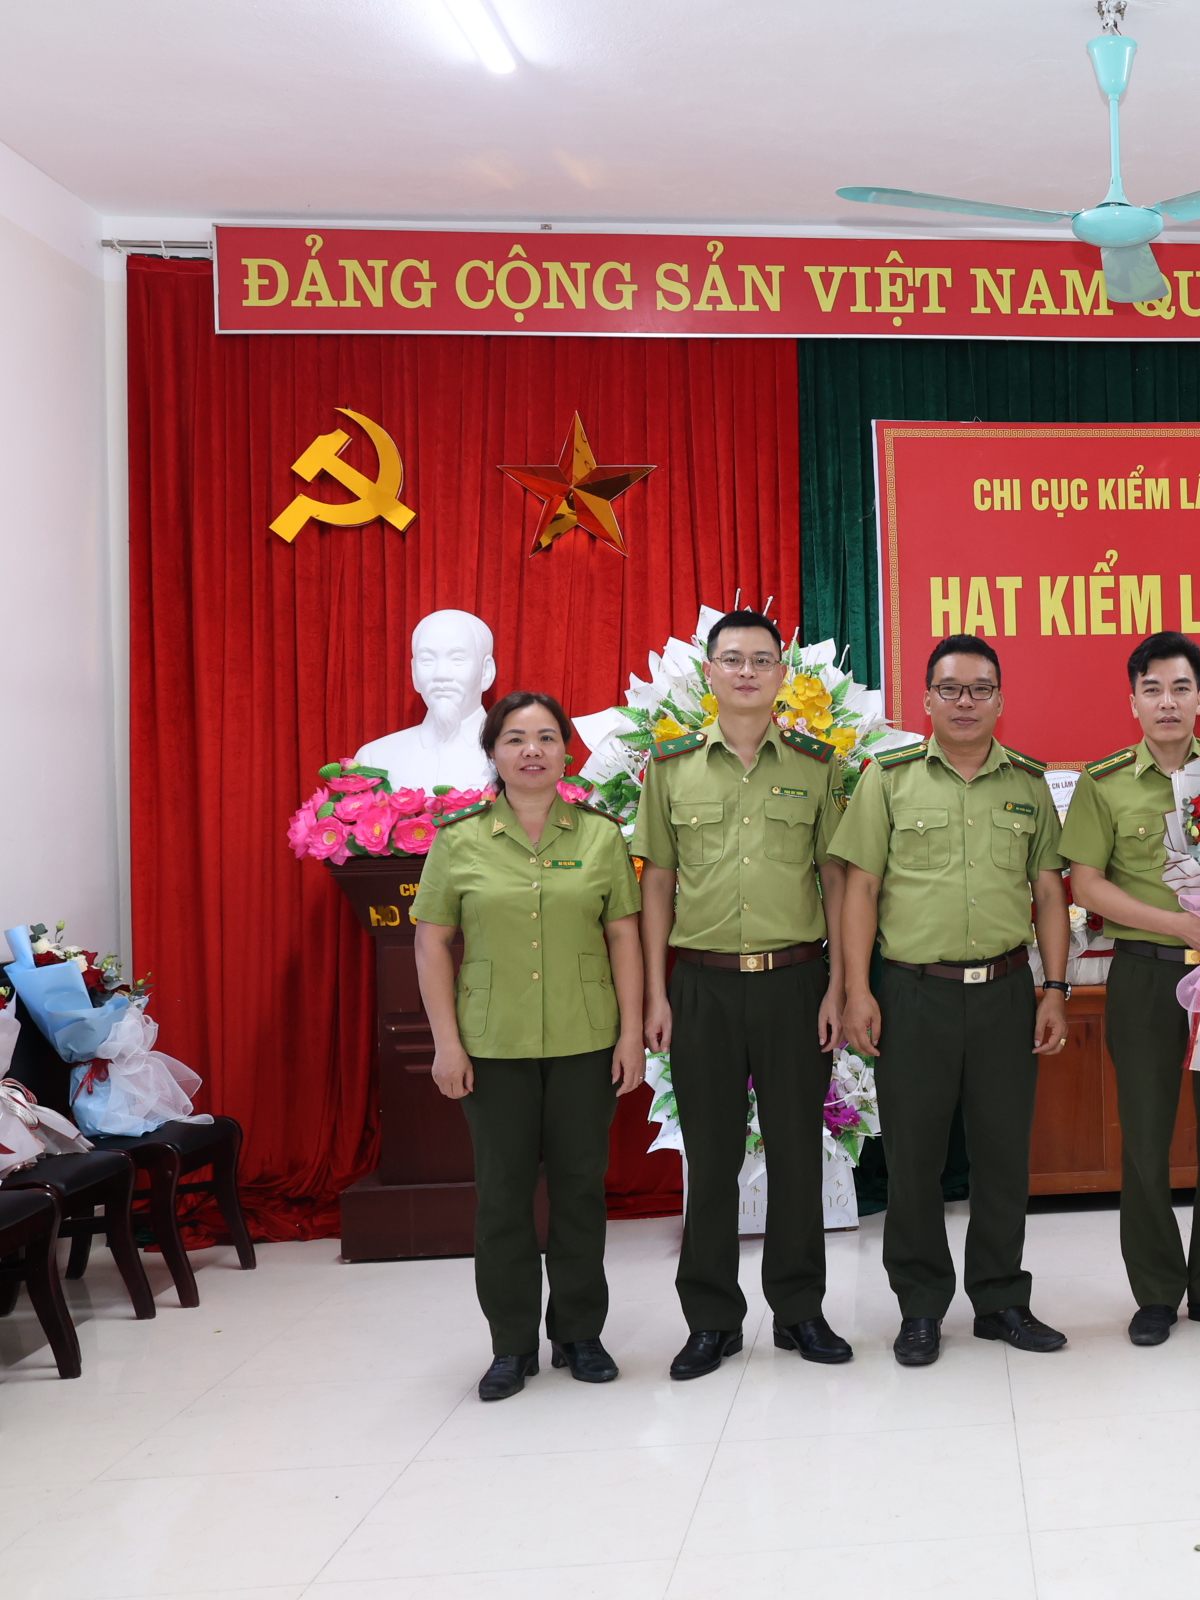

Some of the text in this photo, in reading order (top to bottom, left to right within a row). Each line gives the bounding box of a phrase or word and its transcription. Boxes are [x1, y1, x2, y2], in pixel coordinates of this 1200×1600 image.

[242, 234, 437, 309] ĐẢNG
[456, 245, 639, 323] CỘNG
[656, 241, 786, 312] SẢN
[805, 250, 953, 327] VIỆT
[970, 268, 1115, 316] NAM
[973, 478, 1022, 511] CHI
[1031, 478, 1089, 518] CỤC
[1098, 465, 1170, 510] KIỂM
[1039, 549, 1163, 636] KIỂM
[399, 883, 419, 896] CH
